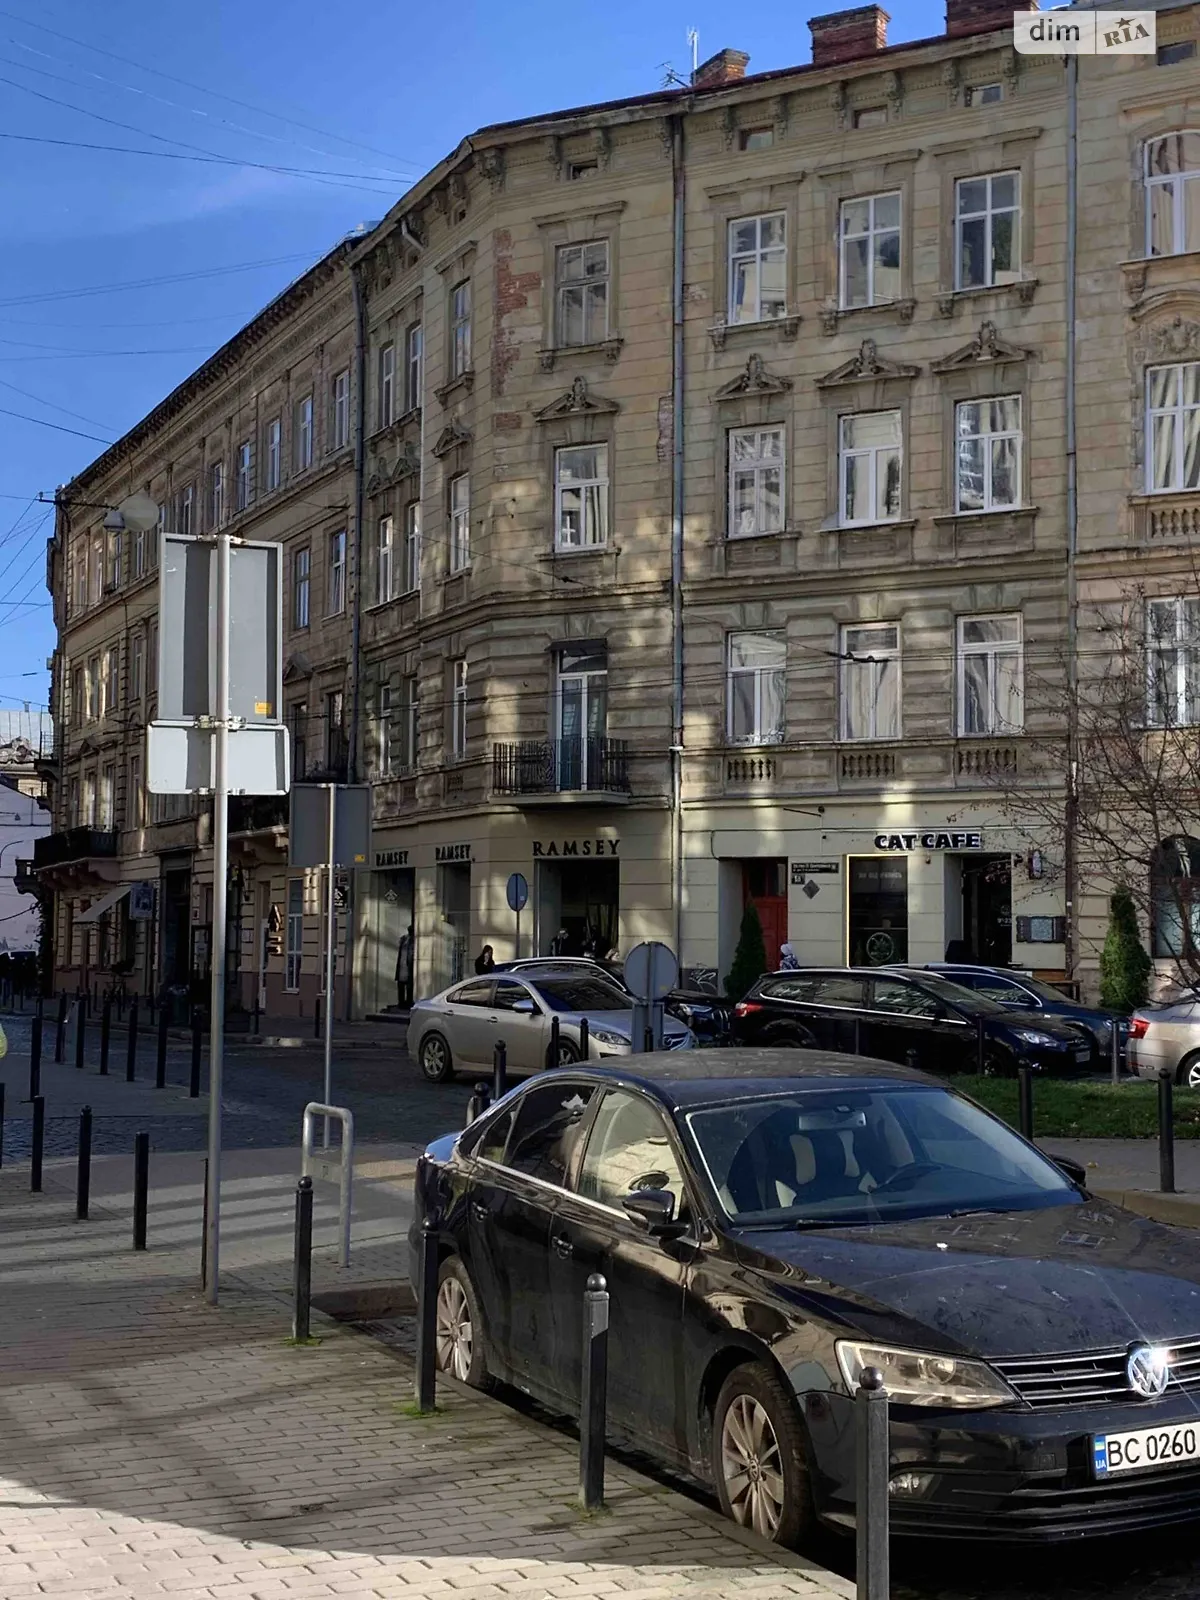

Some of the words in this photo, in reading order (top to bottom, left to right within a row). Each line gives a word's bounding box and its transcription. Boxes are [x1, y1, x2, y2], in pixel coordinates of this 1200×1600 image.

[532, 839, 621, 856] RAMSEY
[874, 832, 918, 850] CAT
[921, 832, 982, 849] CAFE
[375, 850, 409, 866] RAMSEY
[435, 844, 471, 860] RAMSEY
[1107, 1438, 1140, 1467] BC
[1146, 1429, 1196, 1461] 0260
[1095, 1459, 1106, 1469] UA
